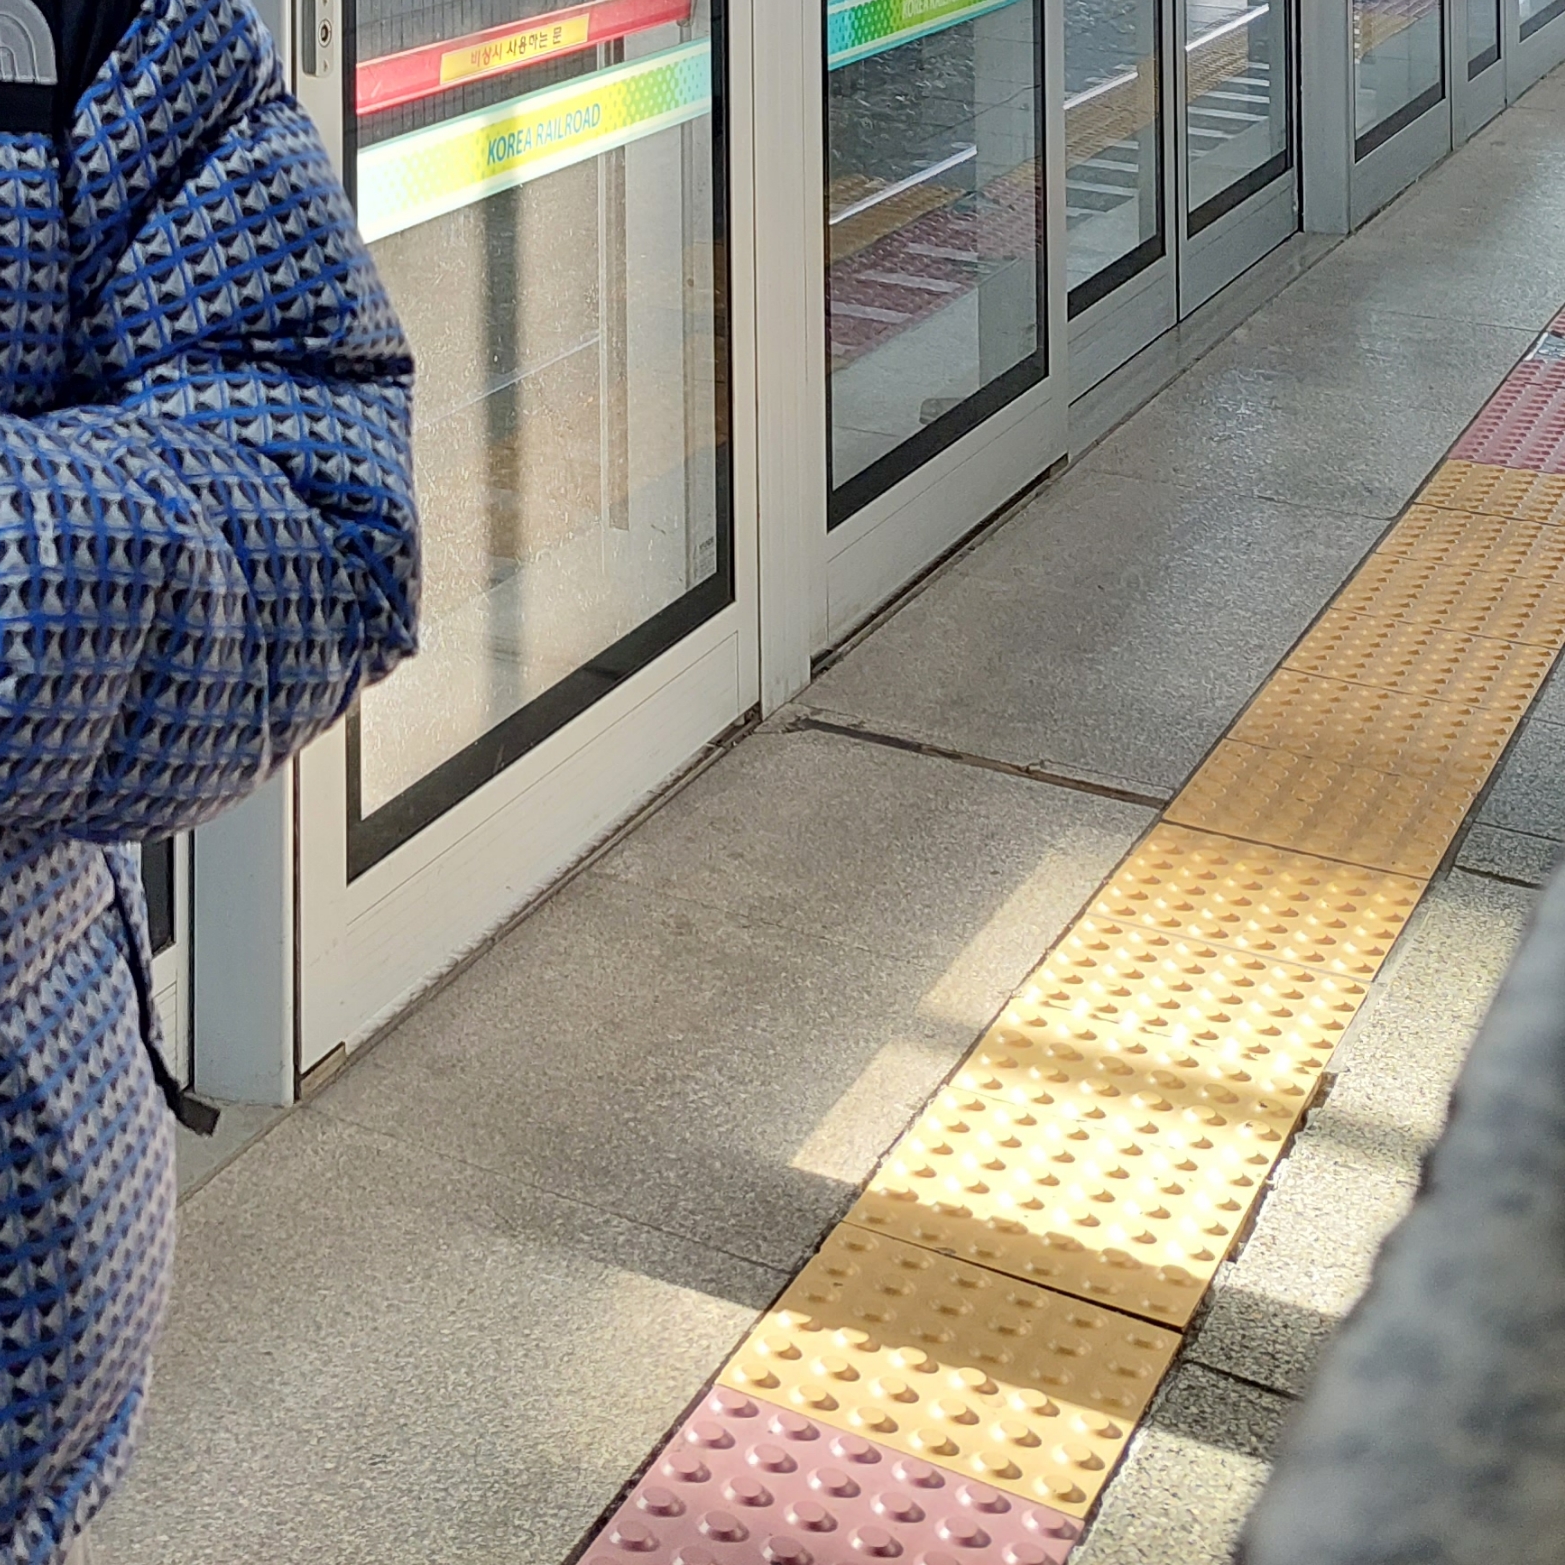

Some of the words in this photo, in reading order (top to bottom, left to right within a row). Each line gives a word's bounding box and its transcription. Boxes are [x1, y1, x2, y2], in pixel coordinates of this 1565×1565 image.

[470, 43, 503, 68] 비상시
[506, 31, 548, 57] 사용하는
[552, 26, 562, 45] 문
[487, 126, 532, 166] KOREA
[535, 102, 602, 150] RAILROAD
